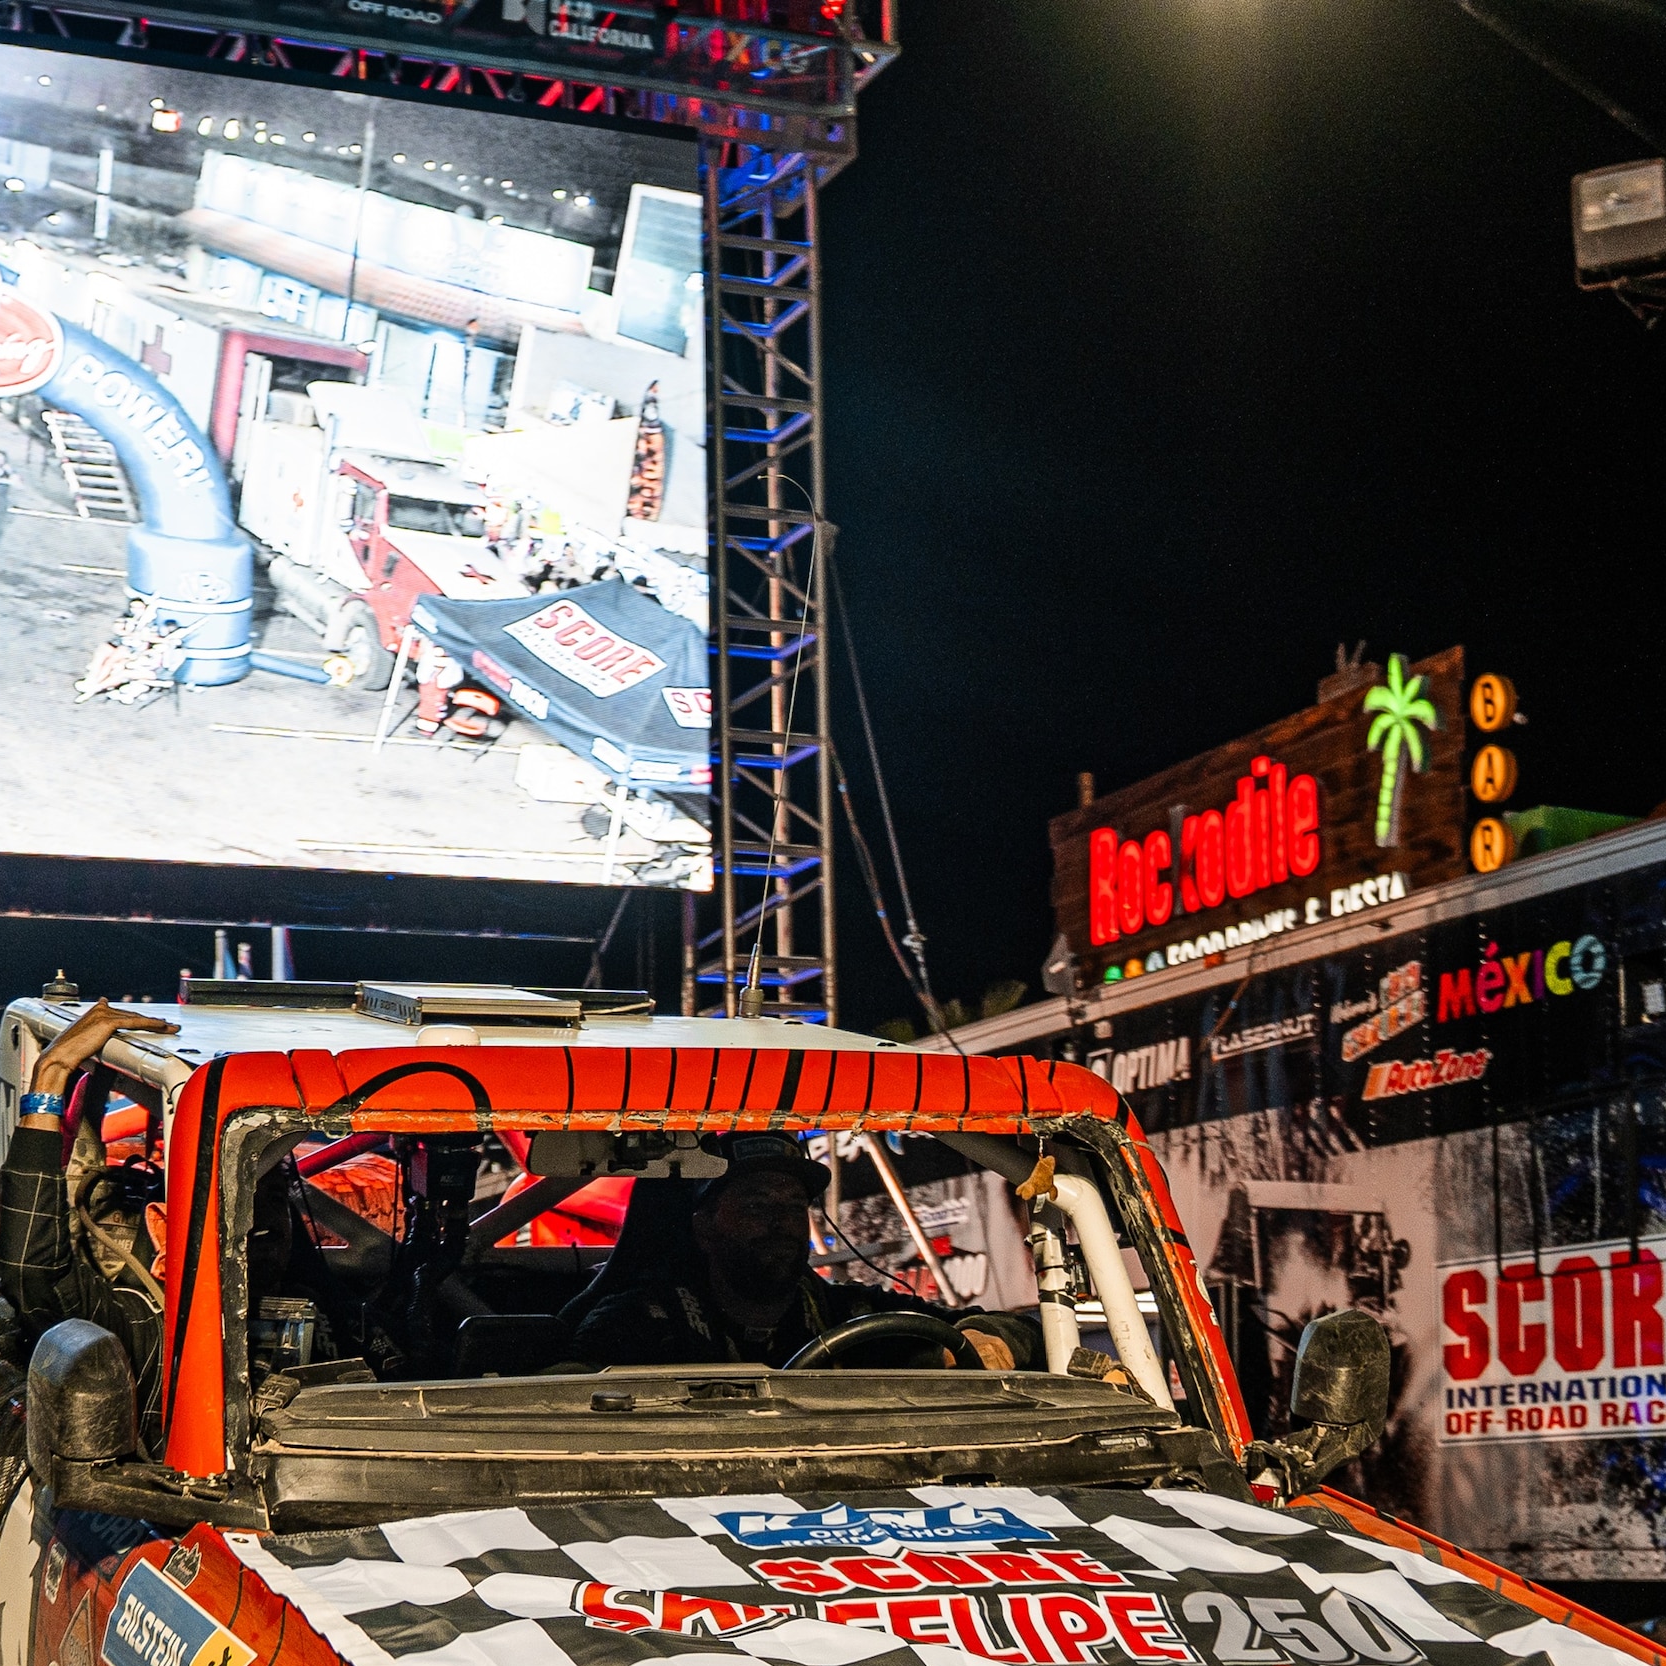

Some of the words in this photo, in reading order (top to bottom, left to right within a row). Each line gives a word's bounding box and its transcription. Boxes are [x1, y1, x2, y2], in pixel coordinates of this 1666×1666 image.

[547, 21, 654, 52] CALIFORNIA
[534, 605, 656, 684] SCORE
[1385, 1048, 1489, 1095] AutoZone
[1445, 1404, 1588, 1436] OFF-ROAD
[737, 1504, 1006, 1533] KING
[751, 1548, 1131, 1597] SCORE
